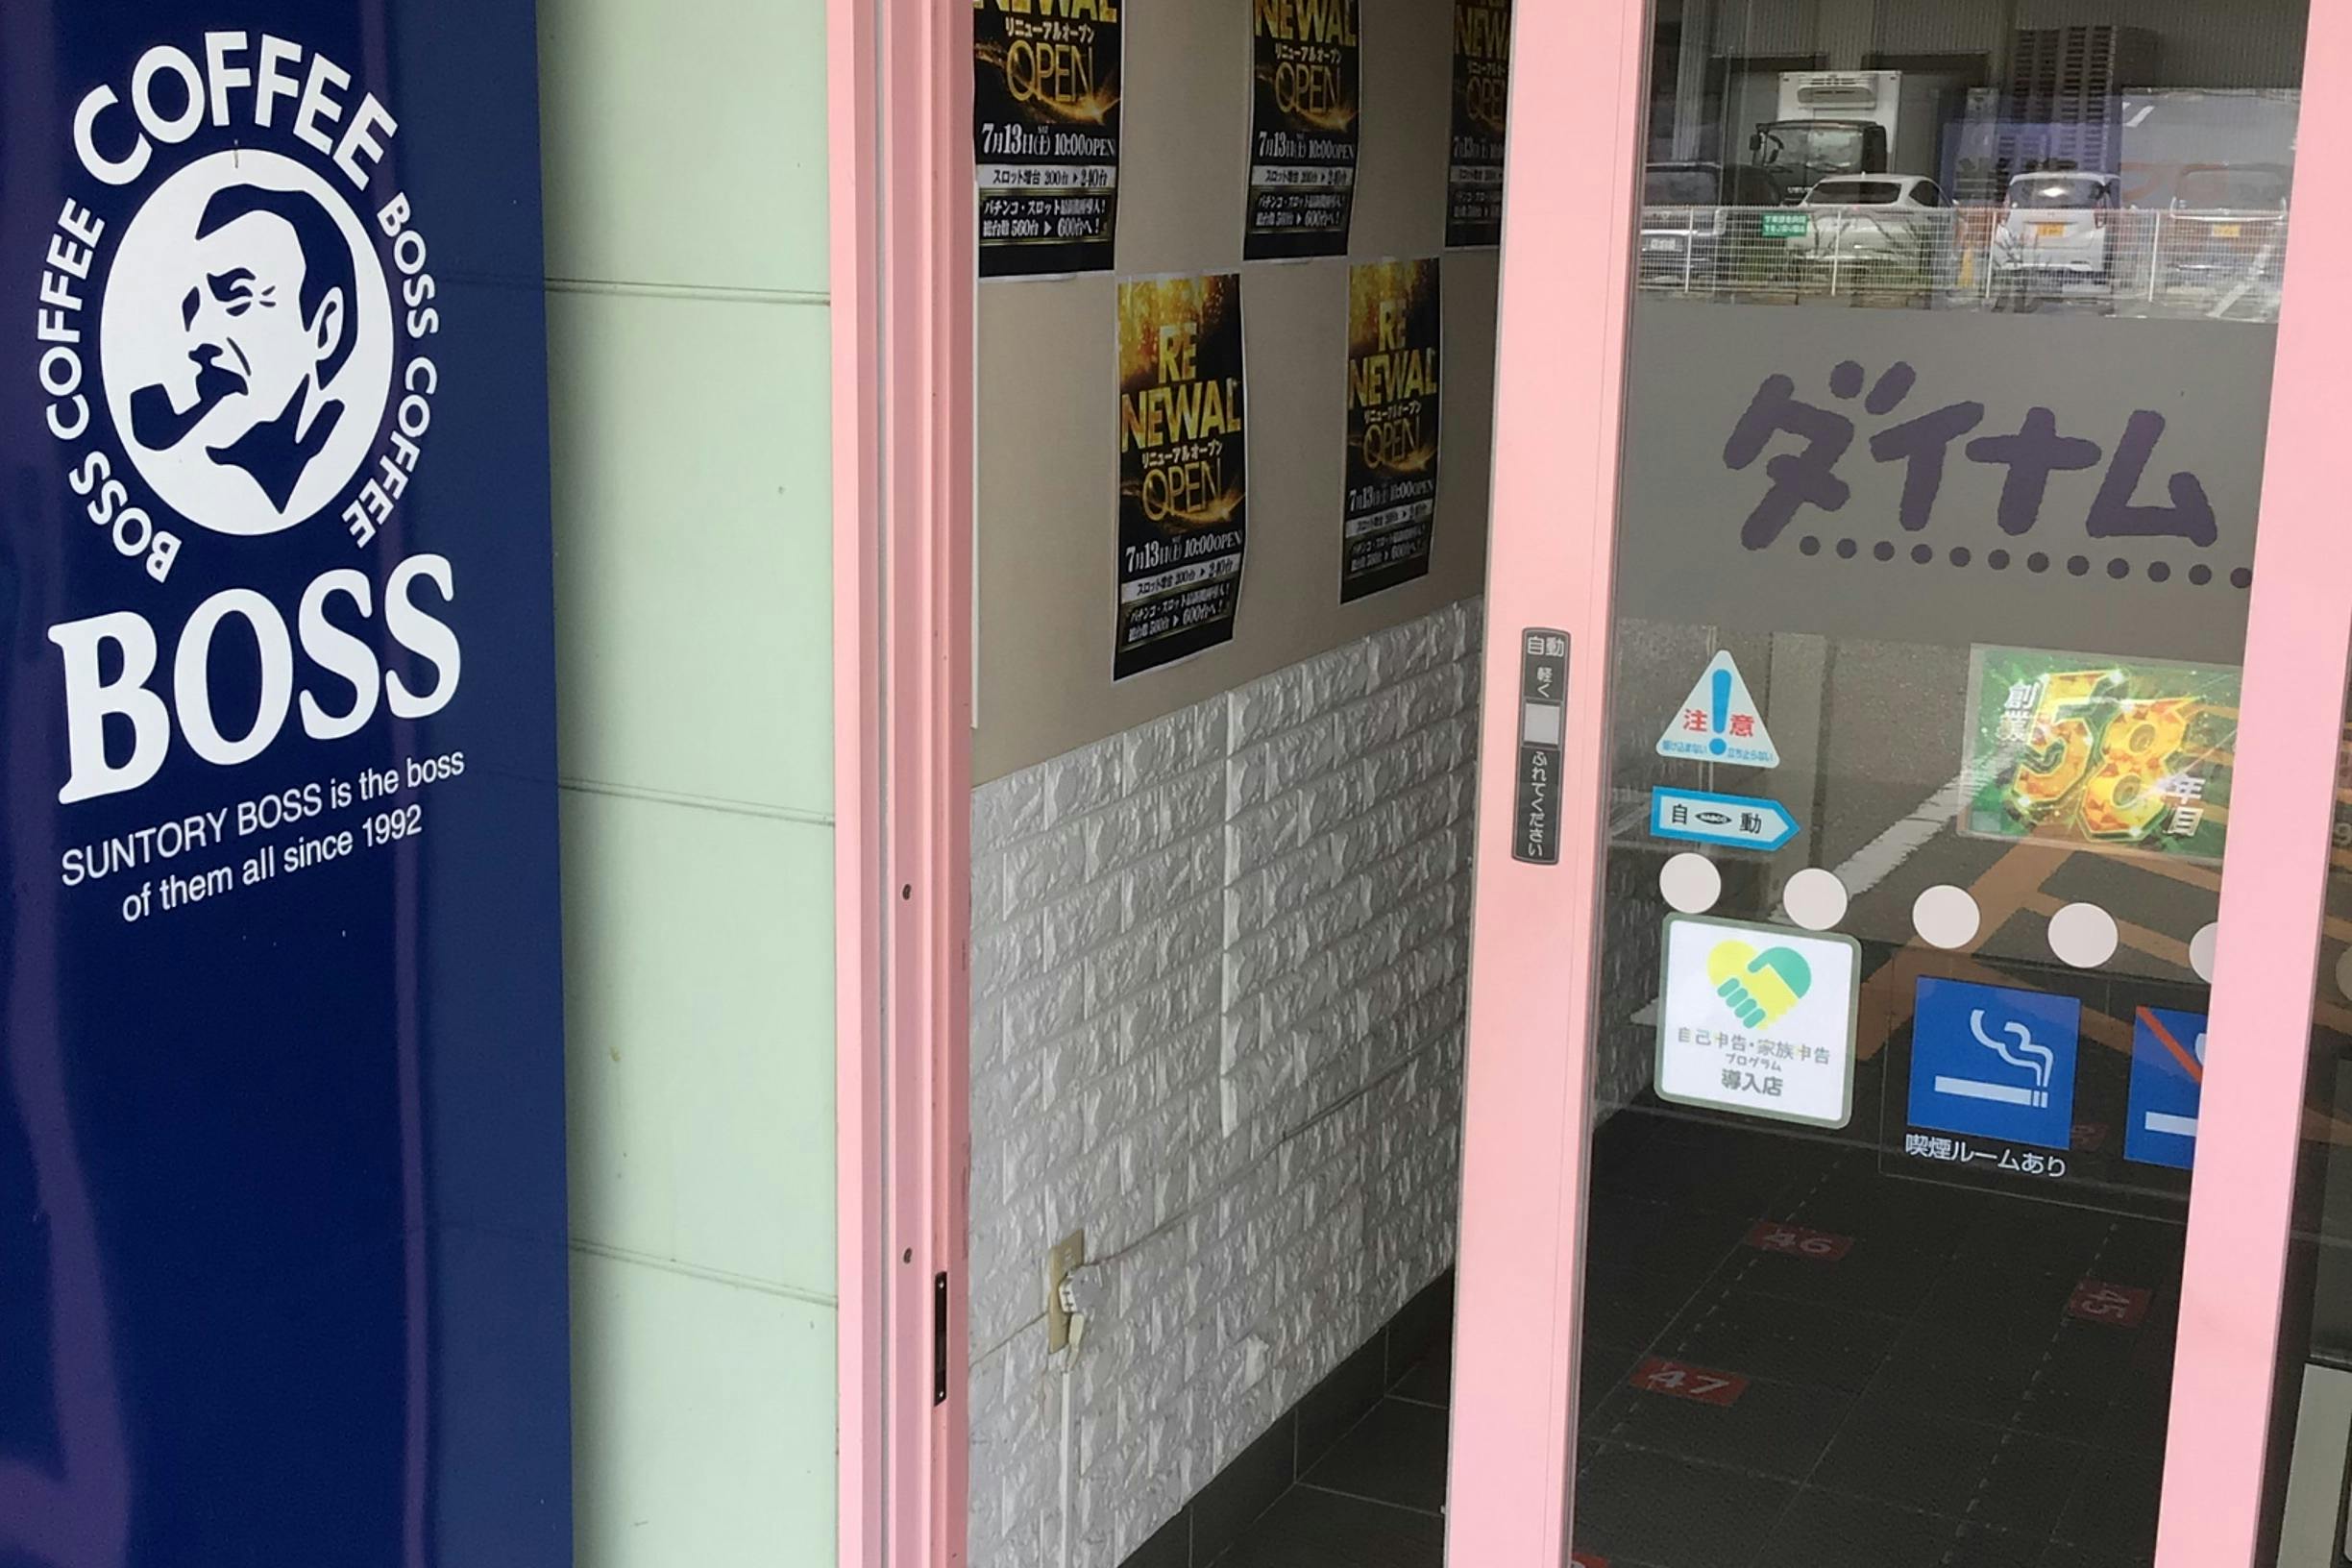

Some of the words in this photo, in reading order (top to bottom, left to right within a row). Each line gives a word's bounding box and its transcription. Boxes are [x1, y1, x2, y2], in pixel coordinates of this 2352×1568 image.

[1005, 16, 1094, 44] リニューアルオープン
[1006, 39, 1094, 102] OPEN
[1275, 61, 1340, 113] OPEN
[74, 32, 397, 190] COFFEE
[378, 192, 438, 338] BOSS
[37, 198, 105, 439] COFFEE
[1158, 322, 1197, 383] RE
[1349, 347, 1437, 409] NEWAL
[1120, 377, 1241, 453] NEWAL
[1363, 415, 1421, 471] OPEN
[342, 357, 437, 548] COFFEE
[1723, 359, 2217, 551] ダイナム
[69, 452, 182, 582] BOSS
[1142, 456, 1222, 523] OPEN
[1527, 636, 1564, 658] 自動
[48, 553, 461, 805] BOSS
[2013, 670, 2200, 838] 58
[61, 808, 229, 886] SUNTORY
[238, 784, 321, 835] BOSS
[331, 779, 351, 808] is
[359, 767, 399, 798] the
[407, 751, 465, 787] boss
[123, 882, 151, 921] of
[159, 865, 233, 909] them
[243, 846, 275, 884] all
[284, 828, 353, 871] since
[363, 804, 421, 847] 1992
[1678, 1027, 1830, 1065] 自己申告・家族申告
[1726, 1053, 1782, 1071] プログラム
[1721, 1068, 1783, 1097] 導入店
[1905, 1134, 2066, 1178] 喫煙ルームあり
[1763, 1228, 1832, 1255] 46
[1648, 1370, 1730, 1395] 47
